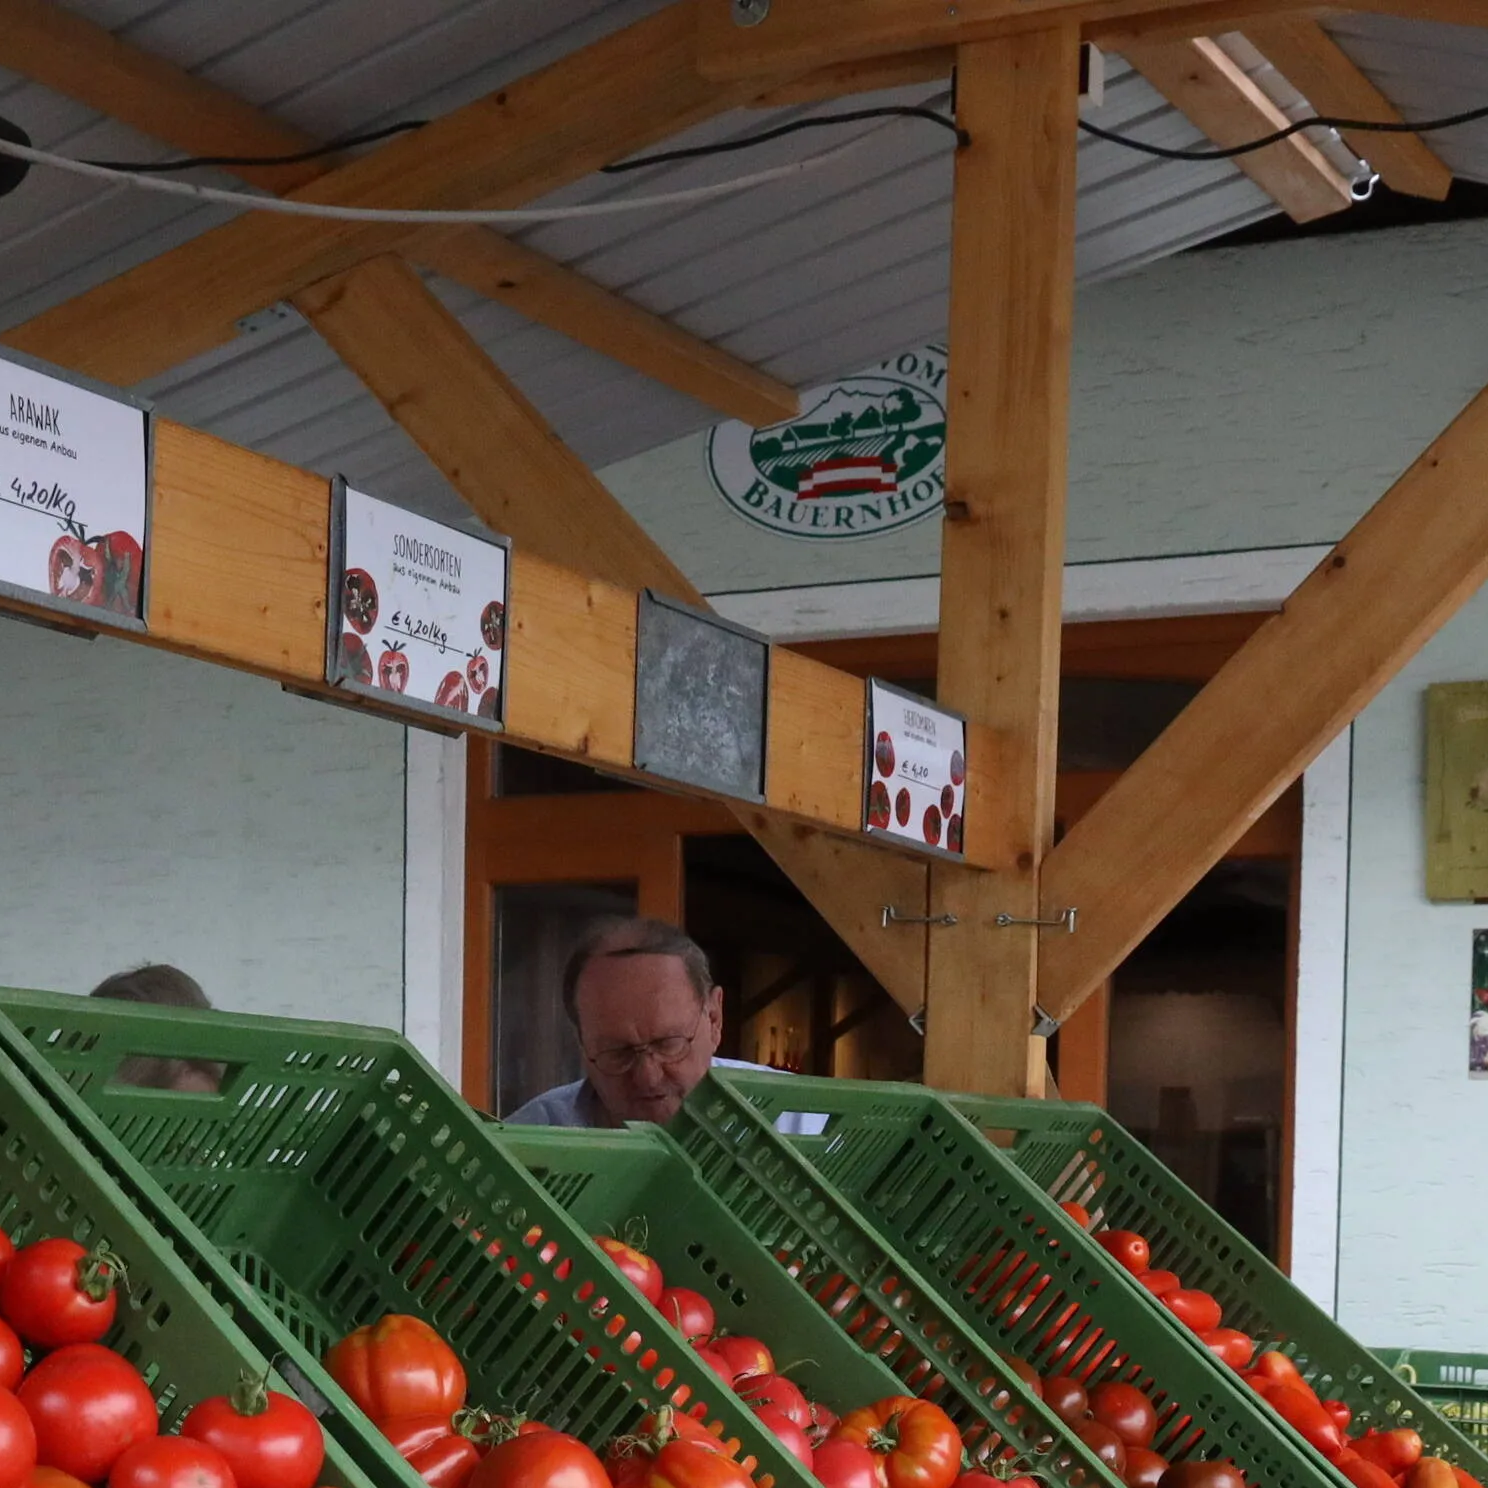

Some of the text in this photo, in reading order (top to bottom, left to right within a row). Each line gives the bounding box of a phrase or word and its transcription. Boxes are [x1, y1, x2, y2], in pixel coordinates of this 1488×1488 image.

[880, 352, 948, 388] OM
[9, 392, 61, 437] ARAWAK
[11, 429, 48, 450] eigenem
[50, 440, 78, 461] Anbau
[392, 533, 463, 579] SONDERSORTEN
